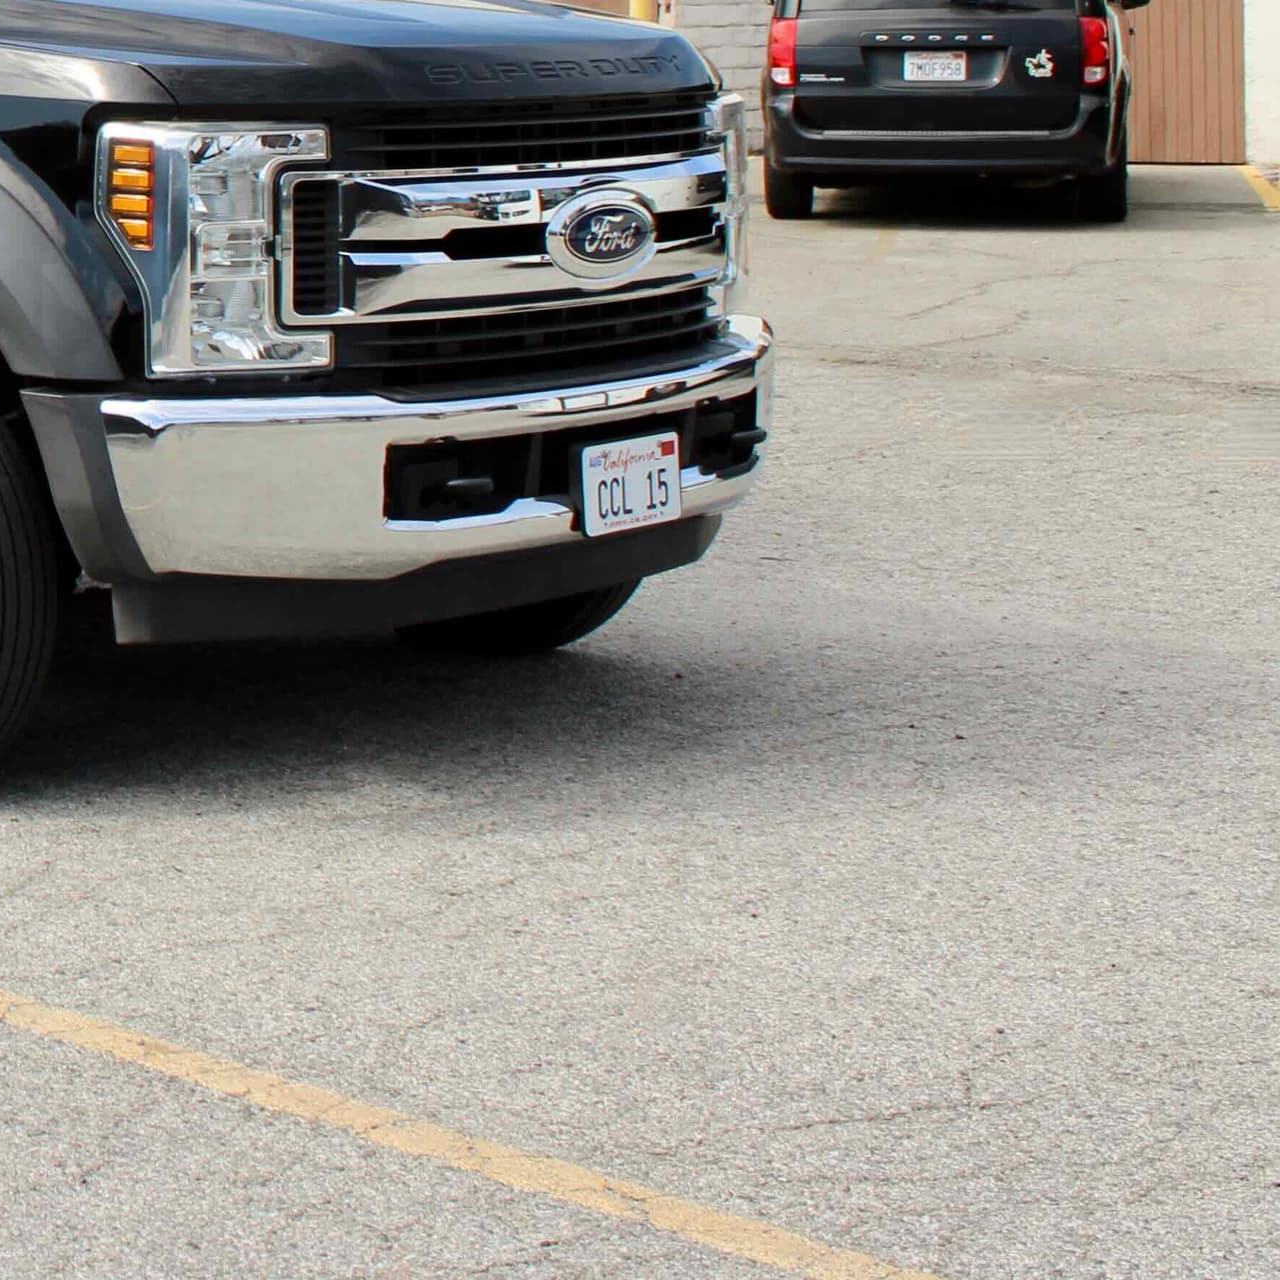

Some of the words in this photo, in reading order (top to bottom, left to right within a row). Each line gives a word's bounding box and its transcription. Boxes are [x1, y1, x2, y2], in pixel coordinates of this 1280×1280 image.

[424, 59, 589, 85] SUPER
[589, 53, 681, 75] DUTY
[585, 215, 637, 253] Ford
[598, 476, 633, 519] CCL
[646, 468, 669, 509] 15
